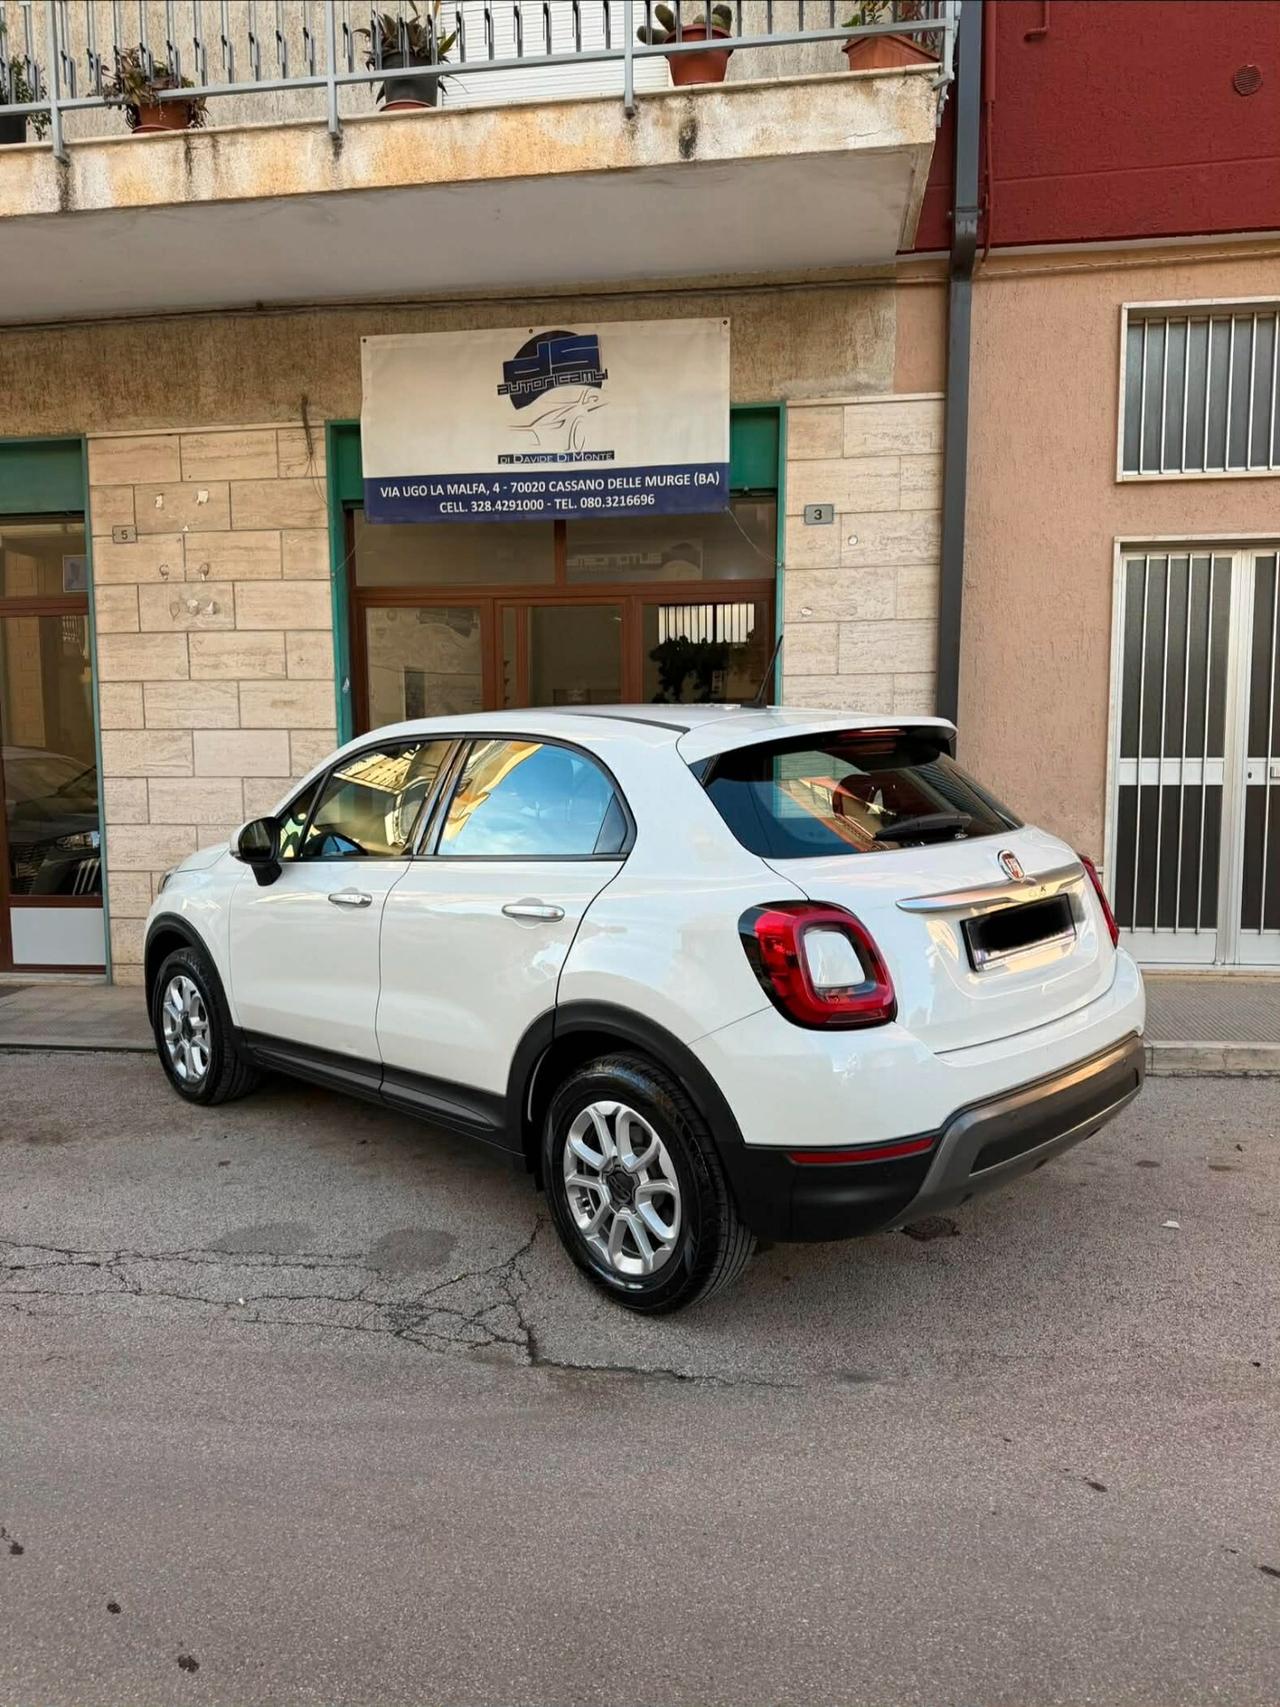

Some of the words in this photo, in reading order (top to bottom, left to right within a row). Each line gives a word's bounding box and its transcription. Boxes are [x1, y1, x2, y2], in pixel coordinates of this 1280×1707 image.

[380, 486, 400, 498] VIA
[403, 485, 428, 497] UGO
[431, 484, 445, 496] LA
[447, 483, 490, 496] MALFA,
[492, 482, 500, 493] 4
[510, 481, 546, 493] 70020
[549, 479, 605, 492] CASSANO
[607, 476, 642, 490] DELLE
[645, 473, 691, 487] MURGE
[694, 471, 720, 487] (BA)
[439, 501, 468, 513] CELL.
[471, 499, 544, 513] 328.4291000
[554, 498, 577, 510] TEL.
[580, 494, 655, 509] 080.3216696
[814, 509, 822, 520] 3
[121, 530, 128, 540] 5
